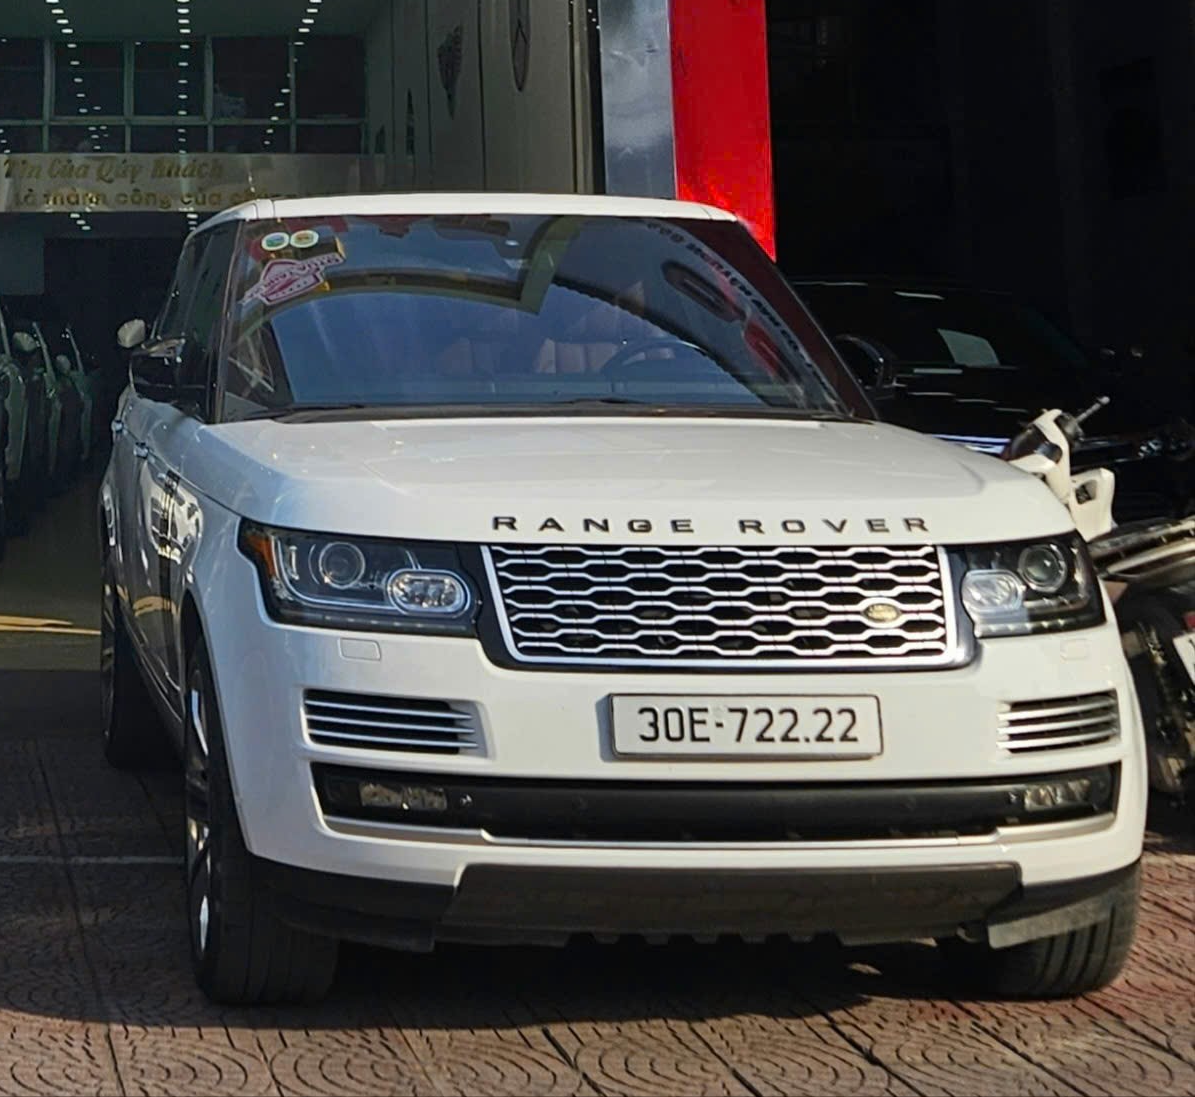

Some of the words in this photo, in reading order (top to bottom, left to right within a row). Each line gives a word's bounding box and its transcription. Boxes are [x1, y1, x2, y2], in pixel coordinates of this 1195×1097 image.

[492, 515, 695, 535] RANGE
[737, 516, 930, 535] ROVER
[636, 705, 859, 744] 30E-722.22
